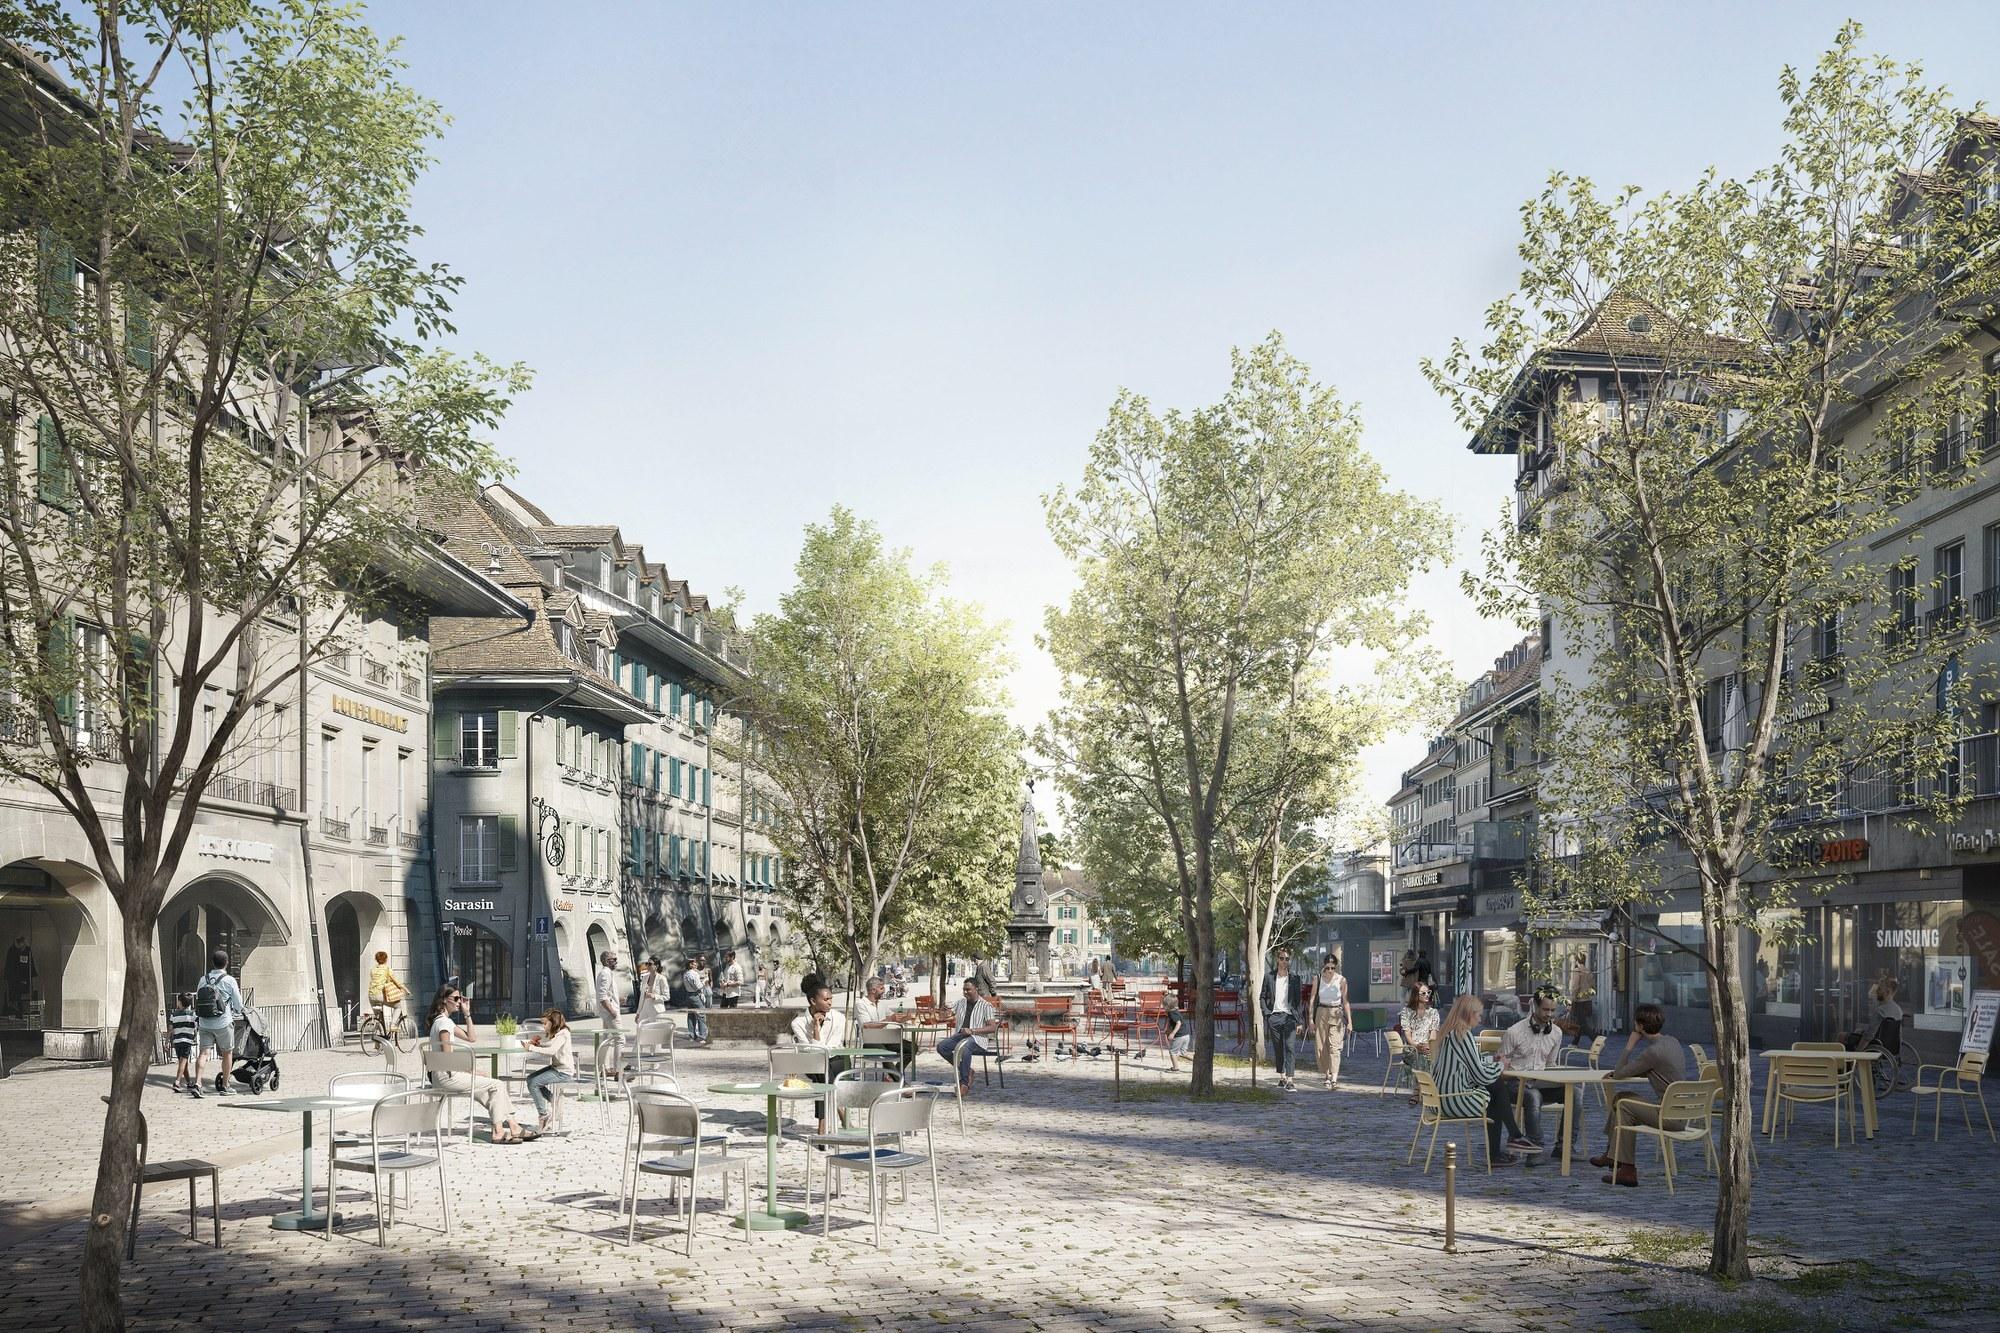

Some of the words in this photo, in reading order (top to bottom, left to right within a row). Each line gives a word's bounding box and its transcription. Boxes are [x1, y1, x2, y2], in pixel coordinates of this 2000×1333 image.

[1945, 829, 2000, 853] Waagha
[444, 899, 494, 911] Sarasin
[1876, 929, 1939, 948] SAMSUNG
